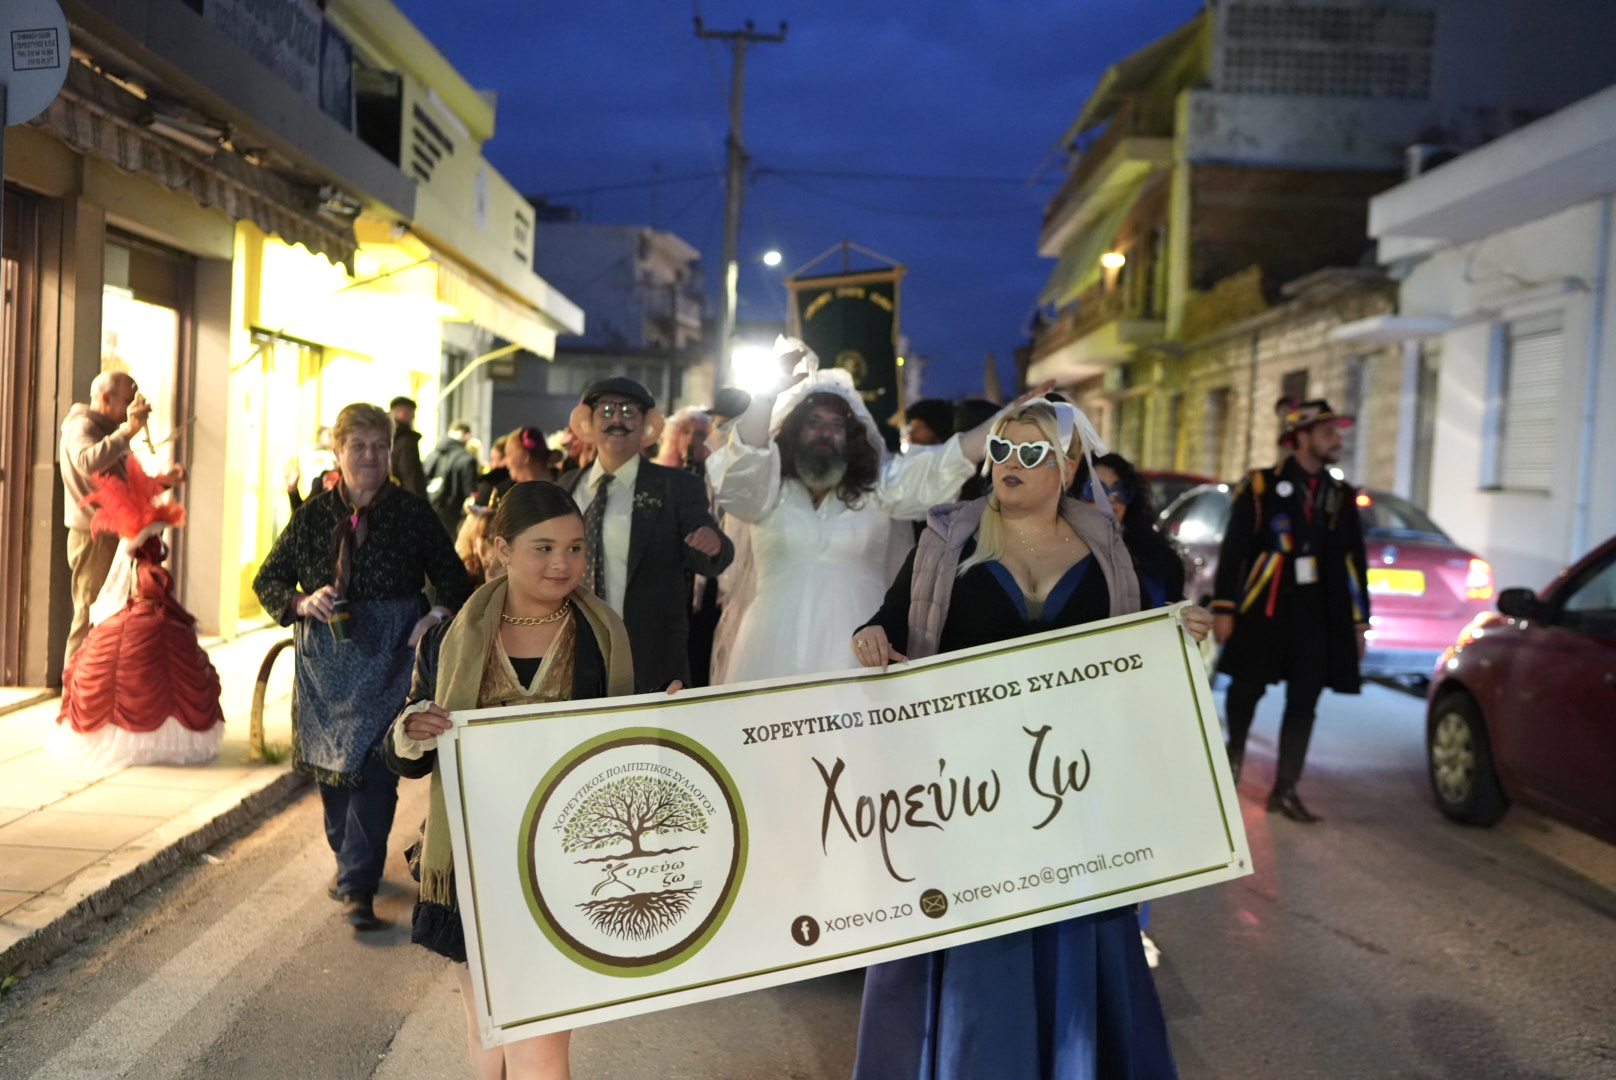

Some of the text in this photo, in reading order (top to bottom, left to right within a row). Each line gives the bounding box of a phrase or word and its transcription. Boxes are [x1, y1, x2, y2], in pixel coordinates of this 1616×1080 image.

[742, 653, 1144, 745] ΧΟΡΕΥΤΙΚΟΣ ΠΟΛΙΤΙΣΤΙΚΟΣ ΣΥΛΛΟΓΟΣ
[552, 762, 717, 833] ΧΟΡΕΥΤΙΚΟΣ ΠΟΛΙΤΙΣΤΙΚΟΣ ΣΥΛΛΟΓΟΣ
[811, 724, 1091, 882] Χορεύω ζω
[662, 872, 686, 888] ζω
[952, 845, 1155, 906] xorevo.zo@gmail.com
[824, 902, 914, 933] xorevo.zo
